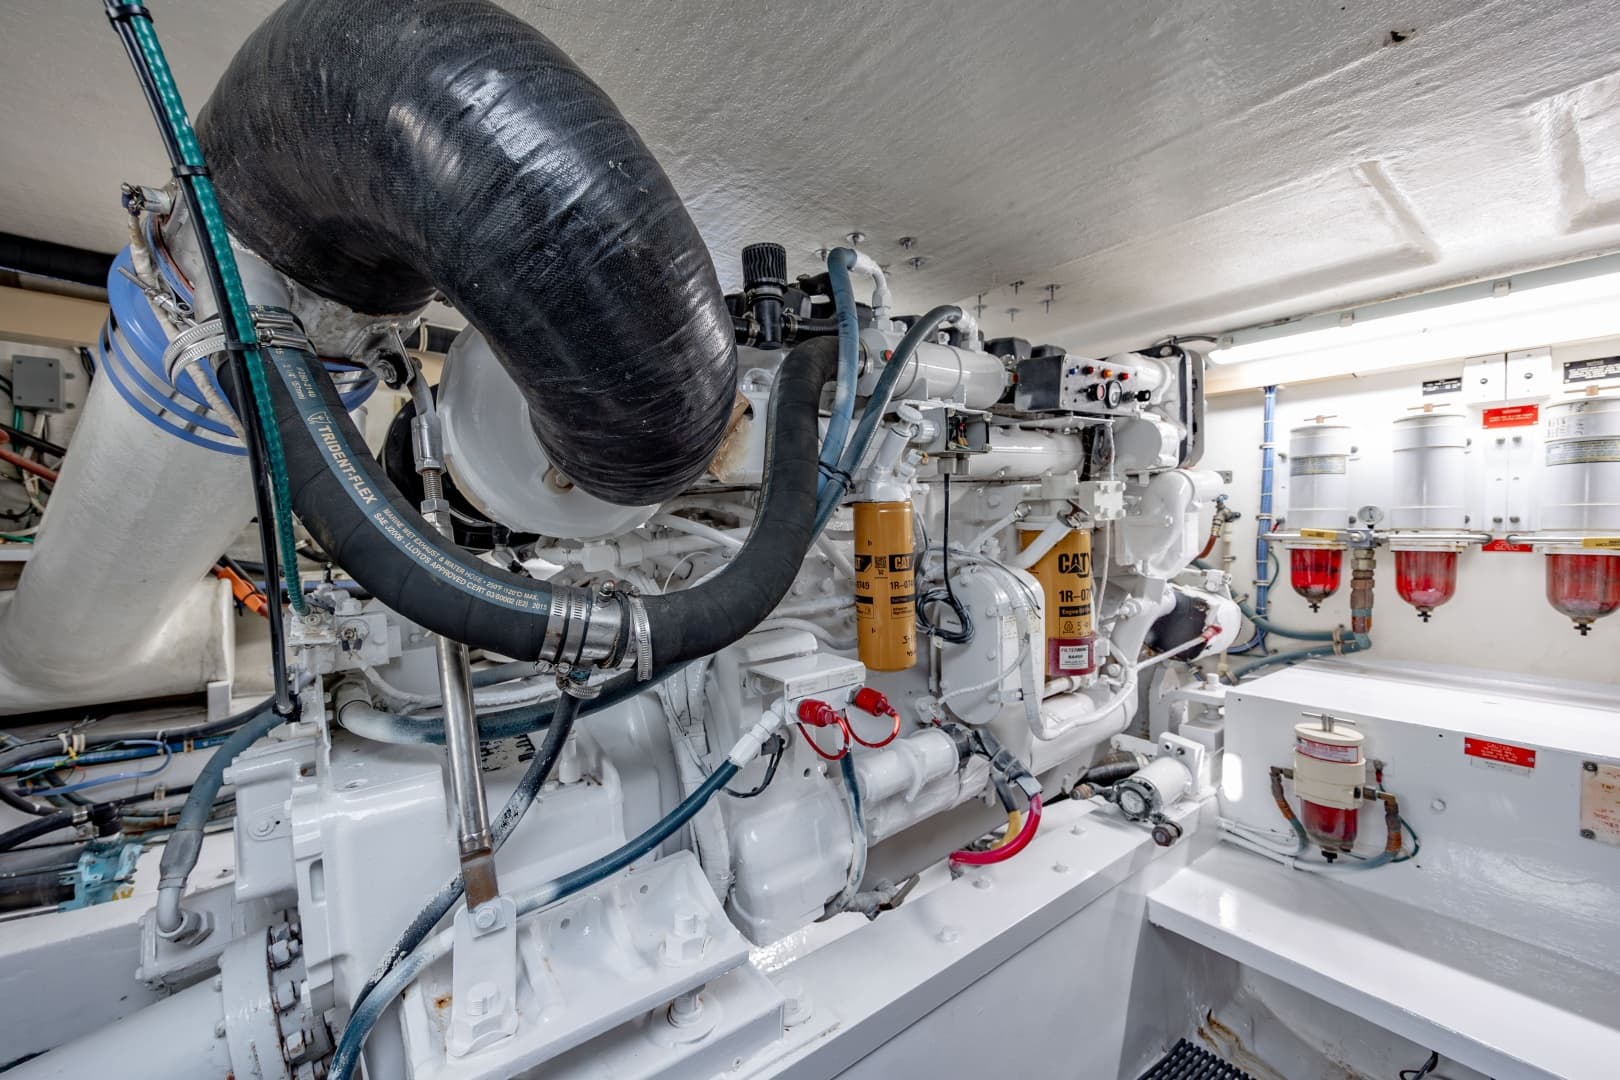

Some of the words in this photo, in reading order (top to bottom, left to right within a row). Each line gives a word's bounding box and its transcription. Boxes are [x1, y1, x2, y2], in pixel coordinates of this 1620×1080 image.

[317, 425, 377, 505] TRIDENT-FLEX
[373, 512, 386, 527] SAE
[385, 525, 403, 542] J2006
[404, 542, 431, 564] LLOYD'S
[430, 560, 468, 585] APPROVED
[466, 581, 487, 596] CERT
[382, 508, 402, 530] MARINE
[403, 527, 417, 541] WET
[414, 536, 440, 558] EXHAUST
[444, 559, 465, 575] WATER
[465, 570, 483, 583] HOSE
[894, 556, 912, 570] CAT
[1058, 553, 1090, 574] CAT
